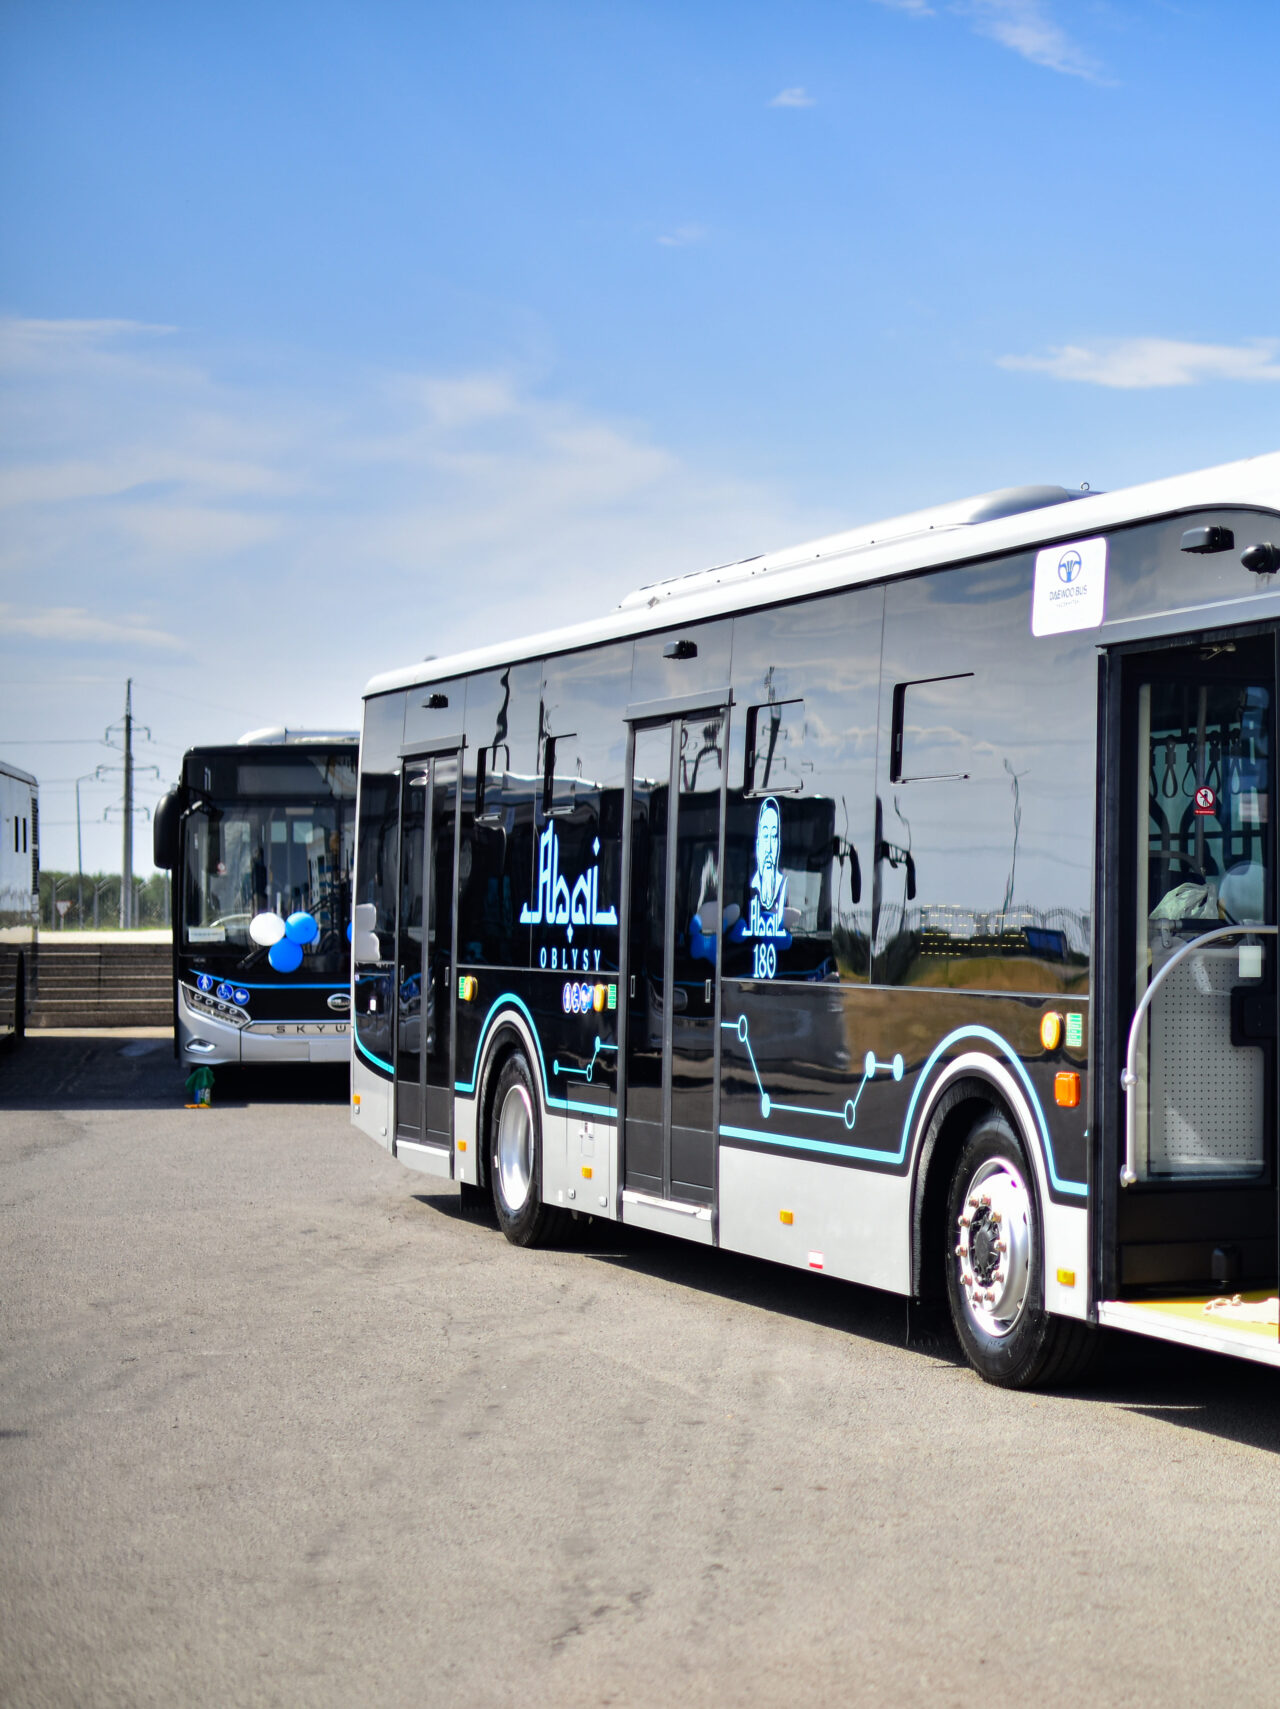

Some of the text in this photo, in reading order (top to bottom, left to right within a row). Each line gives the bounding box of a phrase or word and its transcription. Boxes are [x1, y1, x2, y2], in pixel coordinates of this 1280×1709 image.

[1049, 584, 1088, 601] DAEWOO BUS
[540, 947, 601, 972] OBLYSY
[753, 943, 777, 979] 180
